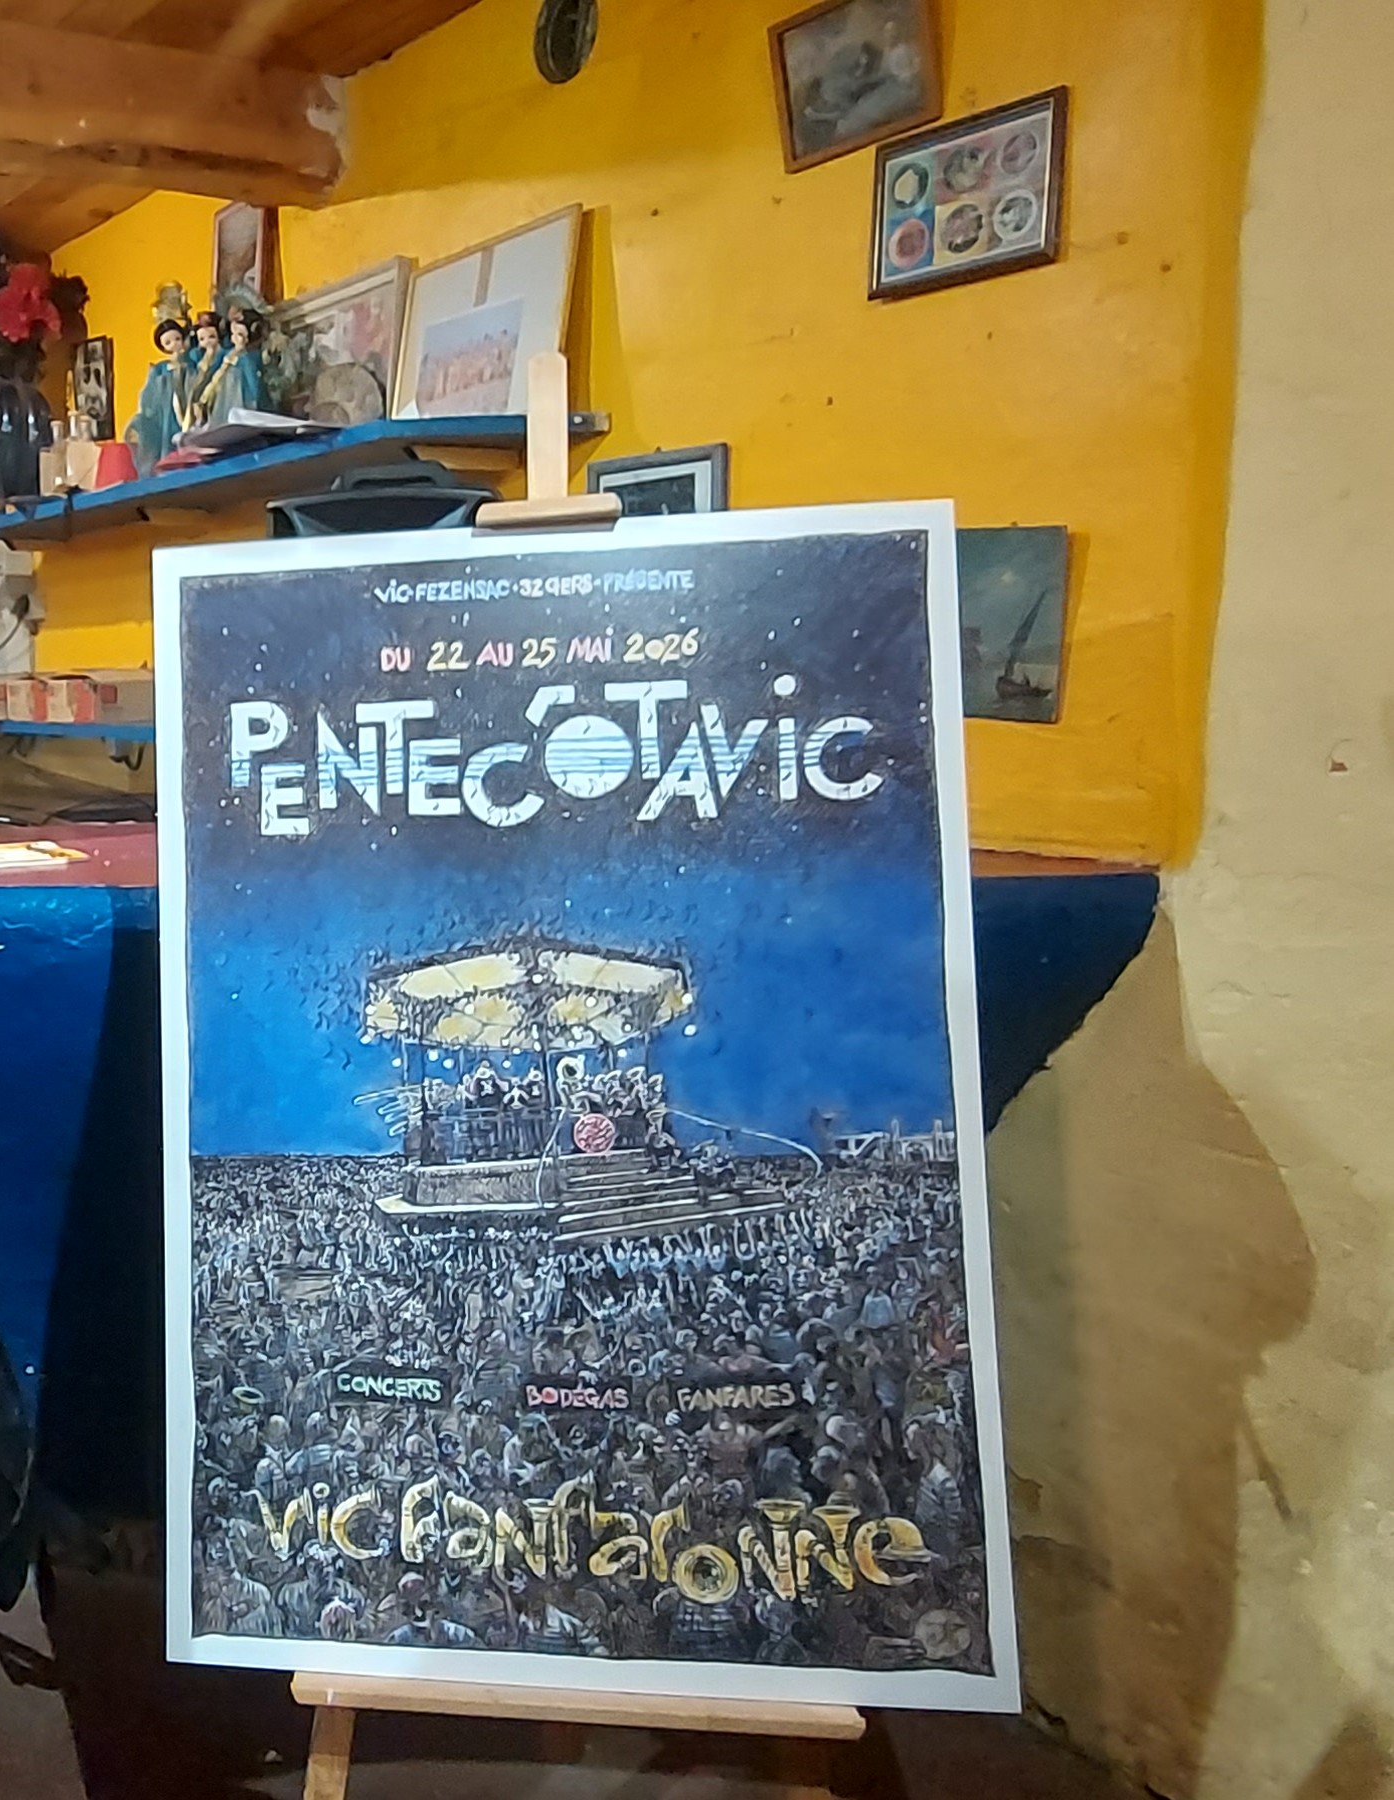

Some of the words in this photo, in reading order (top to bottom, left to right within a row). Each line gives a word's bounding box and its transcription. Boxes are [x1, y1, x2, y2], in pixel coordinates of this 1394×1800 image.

[380, 645, 412, 672] DU
[426, 640, 471, 672] 22
[475, 640, 514, 667] AU
[521, 637, 557, 669] 25
[623, 627, 700, 665] 2026
[336, 1372, 444, 1402] CONCERTS
[676, 1382, 797, 1413] FANFARES
